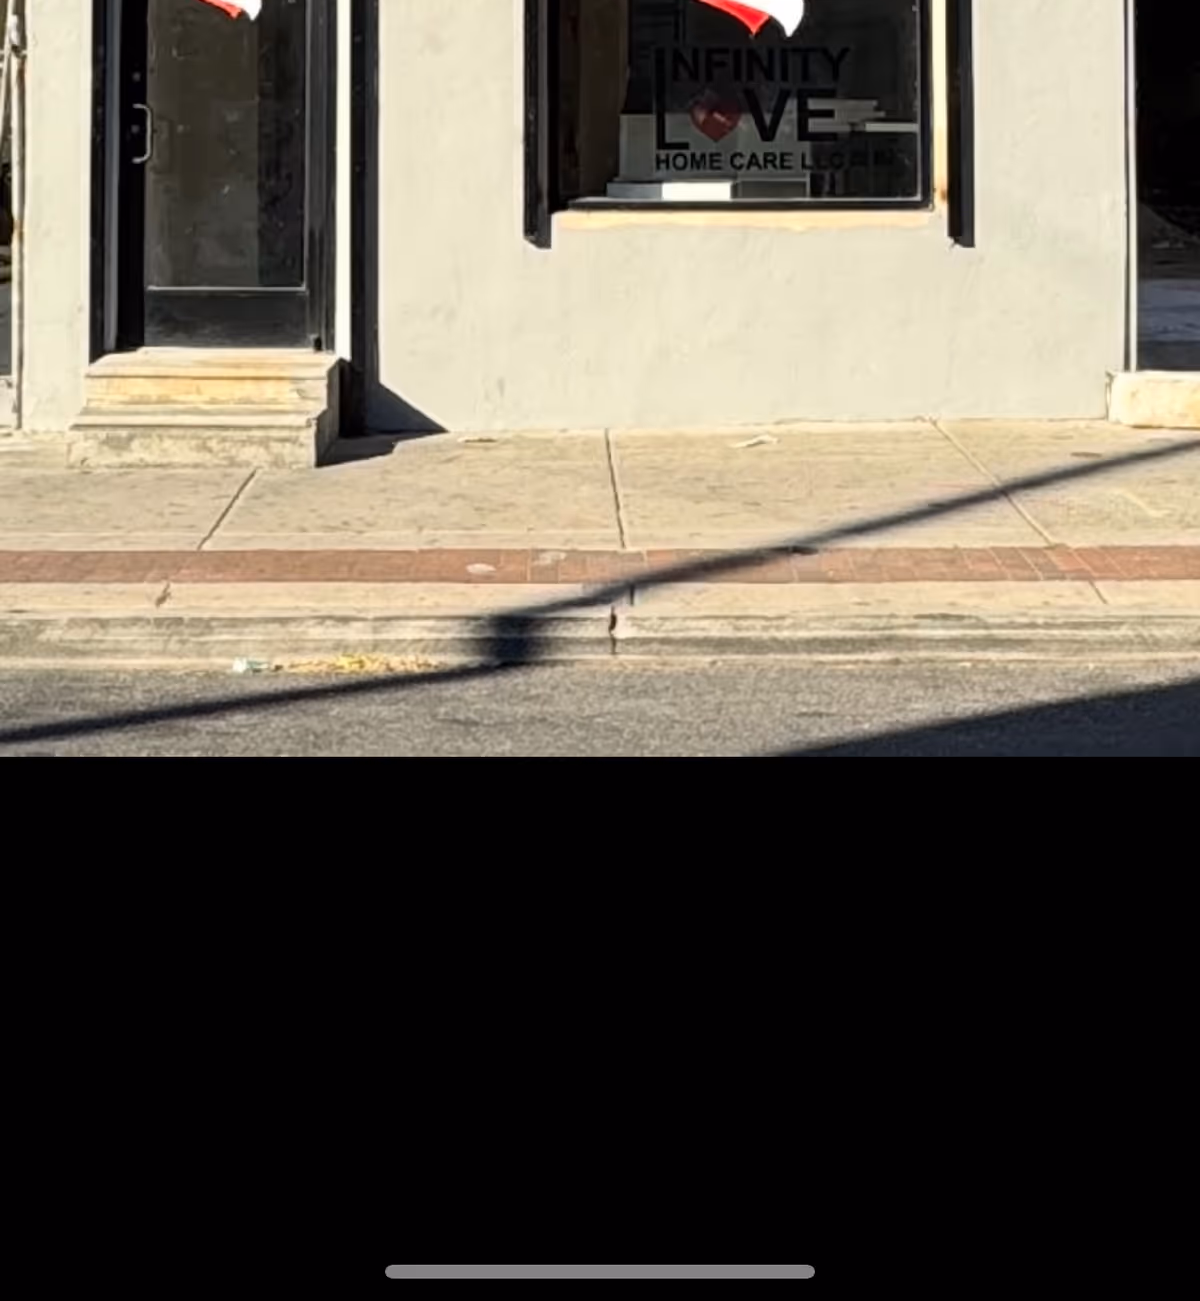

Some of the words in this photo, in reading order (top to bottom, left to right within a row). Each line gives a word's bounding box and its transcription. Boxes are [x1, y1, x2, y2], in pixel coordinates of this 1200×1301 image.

[655, 47, 850, 82] INFINITY
[655, 152, 723, 171] HOME
[730, 152, 794, 170] CARE
[801, 152, 846, 170] LLC
